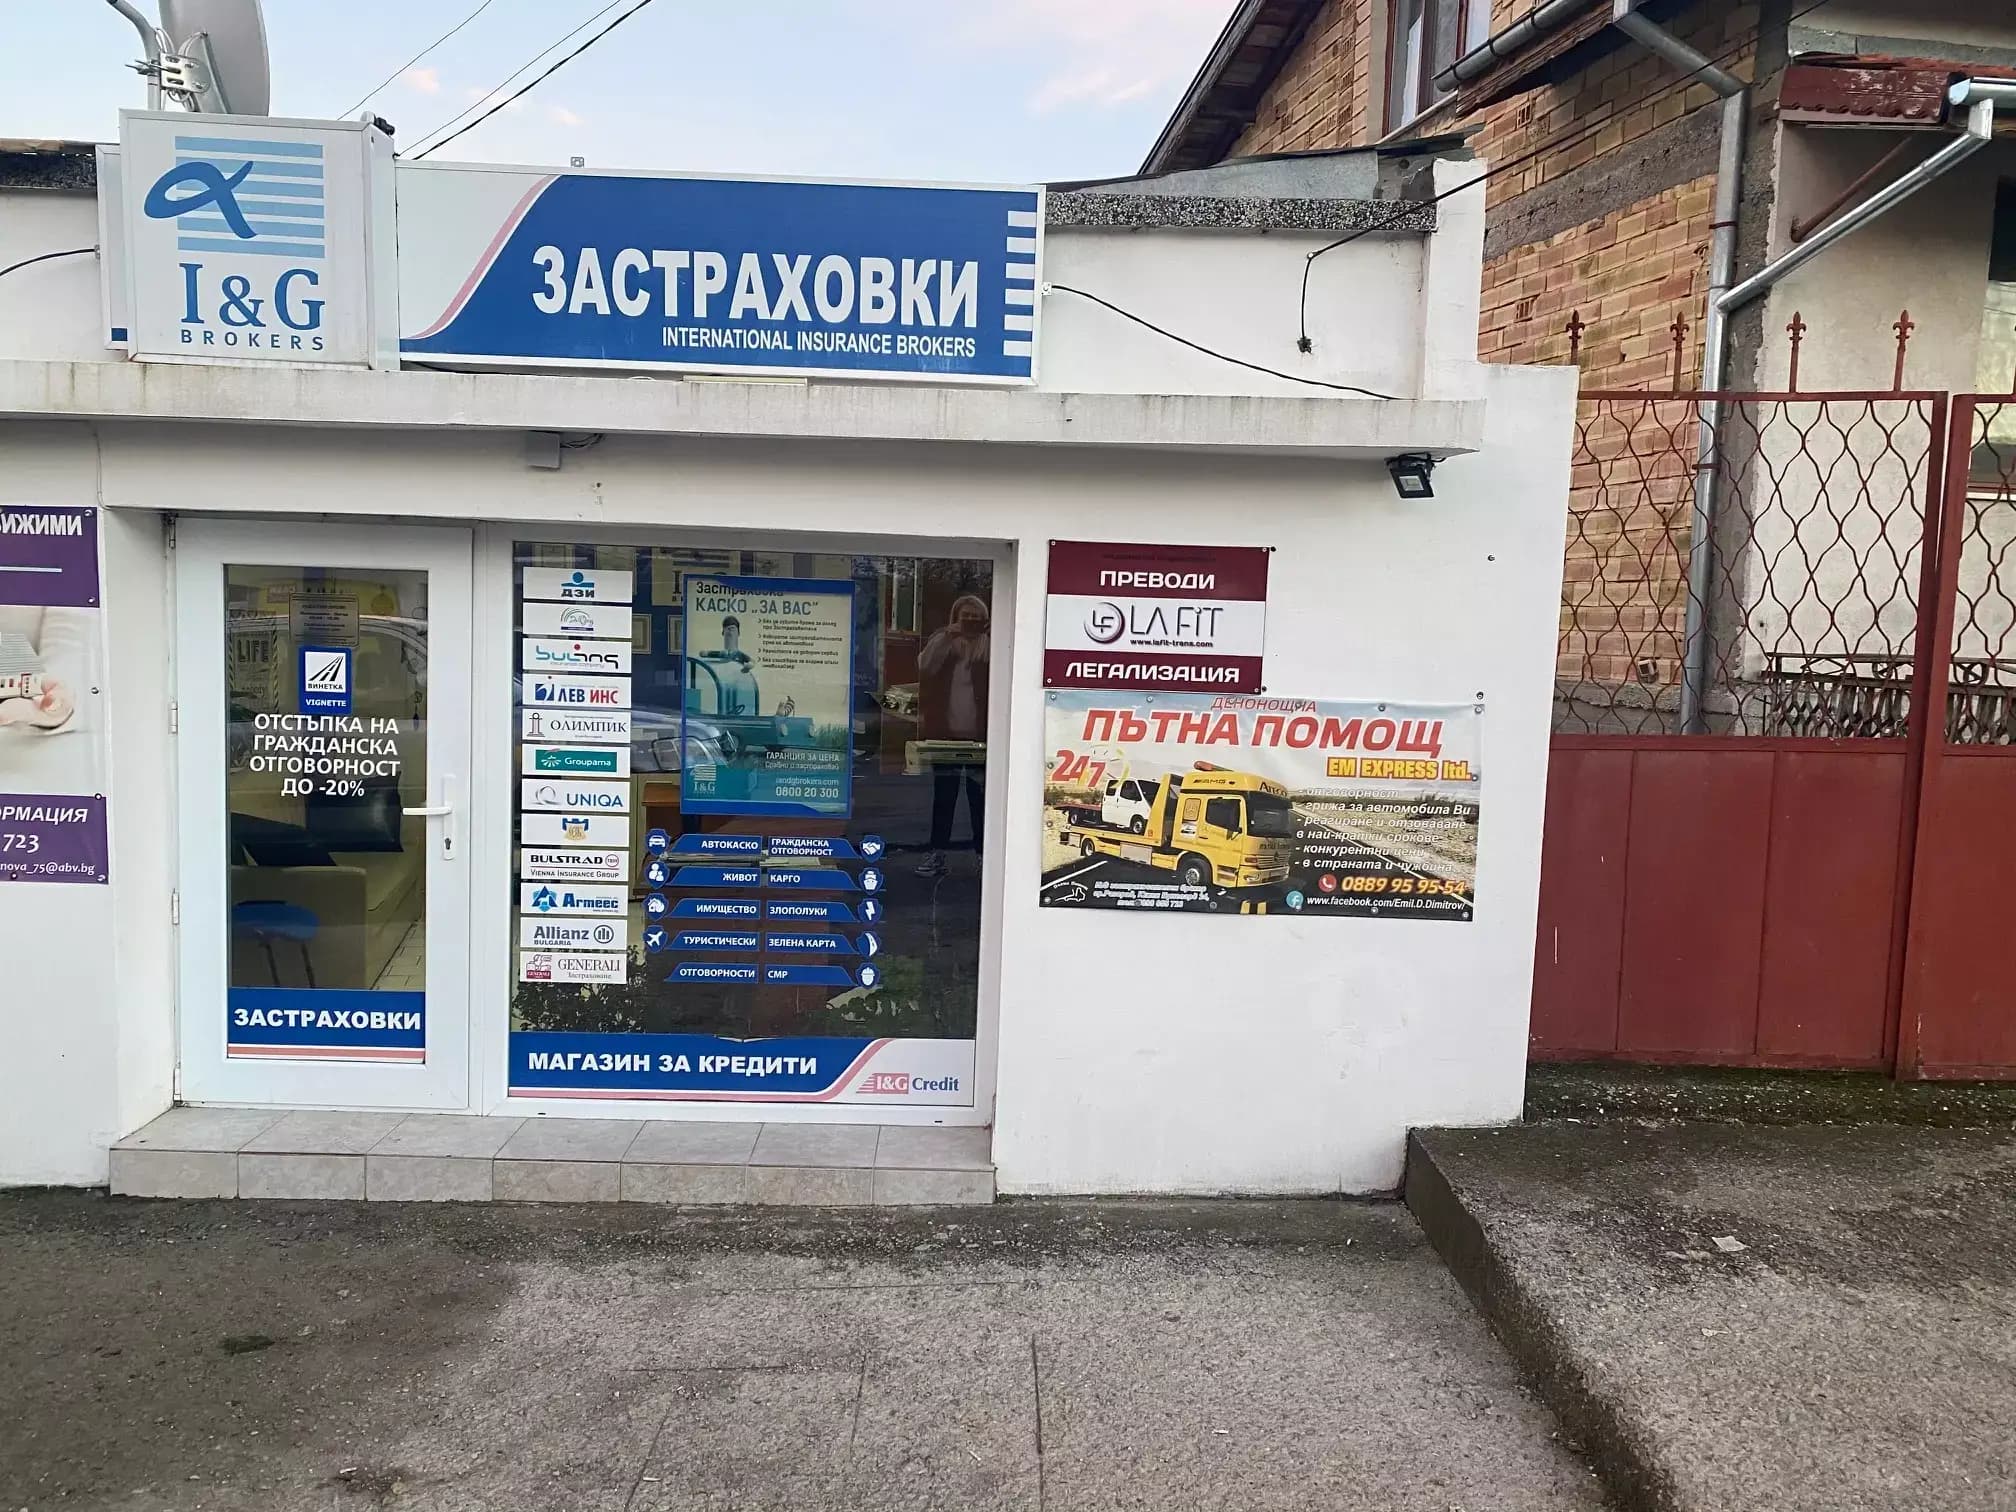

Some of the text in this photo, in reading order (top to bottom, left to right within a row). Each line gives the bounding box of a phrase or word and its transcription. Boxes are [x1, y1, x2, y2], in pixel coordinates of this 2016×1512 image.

[532, 245, 978, 328] ЗАСТРАХОВКИ
[181, 329, 324, 350] BROKERS
[662, 327, 977, 358] INTERNATIONAL INSURANCE BROKERS
[1100, 570, 1215, 590] ПРЕВОДИ
[561, 588, 595, 598] ДЗИ
[696, 597, 747, 613] КАСКО
[1130, 604, 1168, 636] LA
[1066, 662, 1240, 683] ЛЕГАЛИЗАЦИЯ
[558, 688, 619, 704] ЛЕВ ИНС
[305, 699, 347, 707] VIGNETTE
[1211, 697, 1317, 713] ДЕНОНОЩНА
[254, 713, 400, 734] ОТСТЪПКА НА
[550, 720, 627, 733] ОЛИМПИК
[1082, 708, 1444, 759] ПЪТНА ПОМОЩ
[254, 734, 398, 756] ГРАЖДАНСКА
[564, 757, 612, 767] Groupama
[766, 751, 840, 762] ГАРАНЦИЯ ЗА ЦЕНА
[250, 755, 400, 777] ОТГОВОРНОСТ
[1327, 757, 1473, 781] EM EXPRESS ltd.
[281, 778, 365, 797] ДО -20%
[776, 787, 839, 798] 0800 20 300
[1307, 788, 1399, 799] отговорност
[567, 793, 624, 807] UNIQA
[1306, 802, 1345, 812] грижа
[1367, 803, 1450, 815] автомобила
[1453, 805, 1471, 815] Ви
[1304, 817, 1373, 827] реагиране
[3, 834, 39, 853] 723
[701, 840, 758, 850] АВТОКАСКО
[771, 838, 829, 848] ГРАЖДАНСКА
[1387, 834, 1439, 843] срокове
[771, 847, 834, 856] ОТГОВОРНОСТ
[1303, 844, 1425, 857] конкурентни цени
[530, 854, 603, 864] BULSTRAD
[1314, 858, 1382, 870] страната
[723, 873, 757, 882] ЖИВОТ
[770, 874, 800, 883] КАРГО
[1342, 876, 1388, 892] 0889
[1390, 877, 1414, 894] 95
[562, 892, 619, 908] Armeec
[696, 905, 757, 915] ИМУЩЕСТВО
[770, 907, 827, 916] ЗЛОПОЛУКИ
[534, 925, 589, 940] Allianz
[684, 936, 756, 946] ТУРИСТИЧЕСКИ
[769, 939, 836, 948] ЗЕЛЕНА КАРТА
[558, 959, 620, 971] GENERALI
[679, 968, 755, 978] ОТГОВОРНОСТИ
[768, 970, 788, 979] СМР
[234, 1008, 421, 1030] ЗАСТРАХОВКИ
[528, 1052, 817, 1077] МАГАЗИН ЗА КРЕДИТИ
[876, 1075, 960, 1091] I&G Credit
